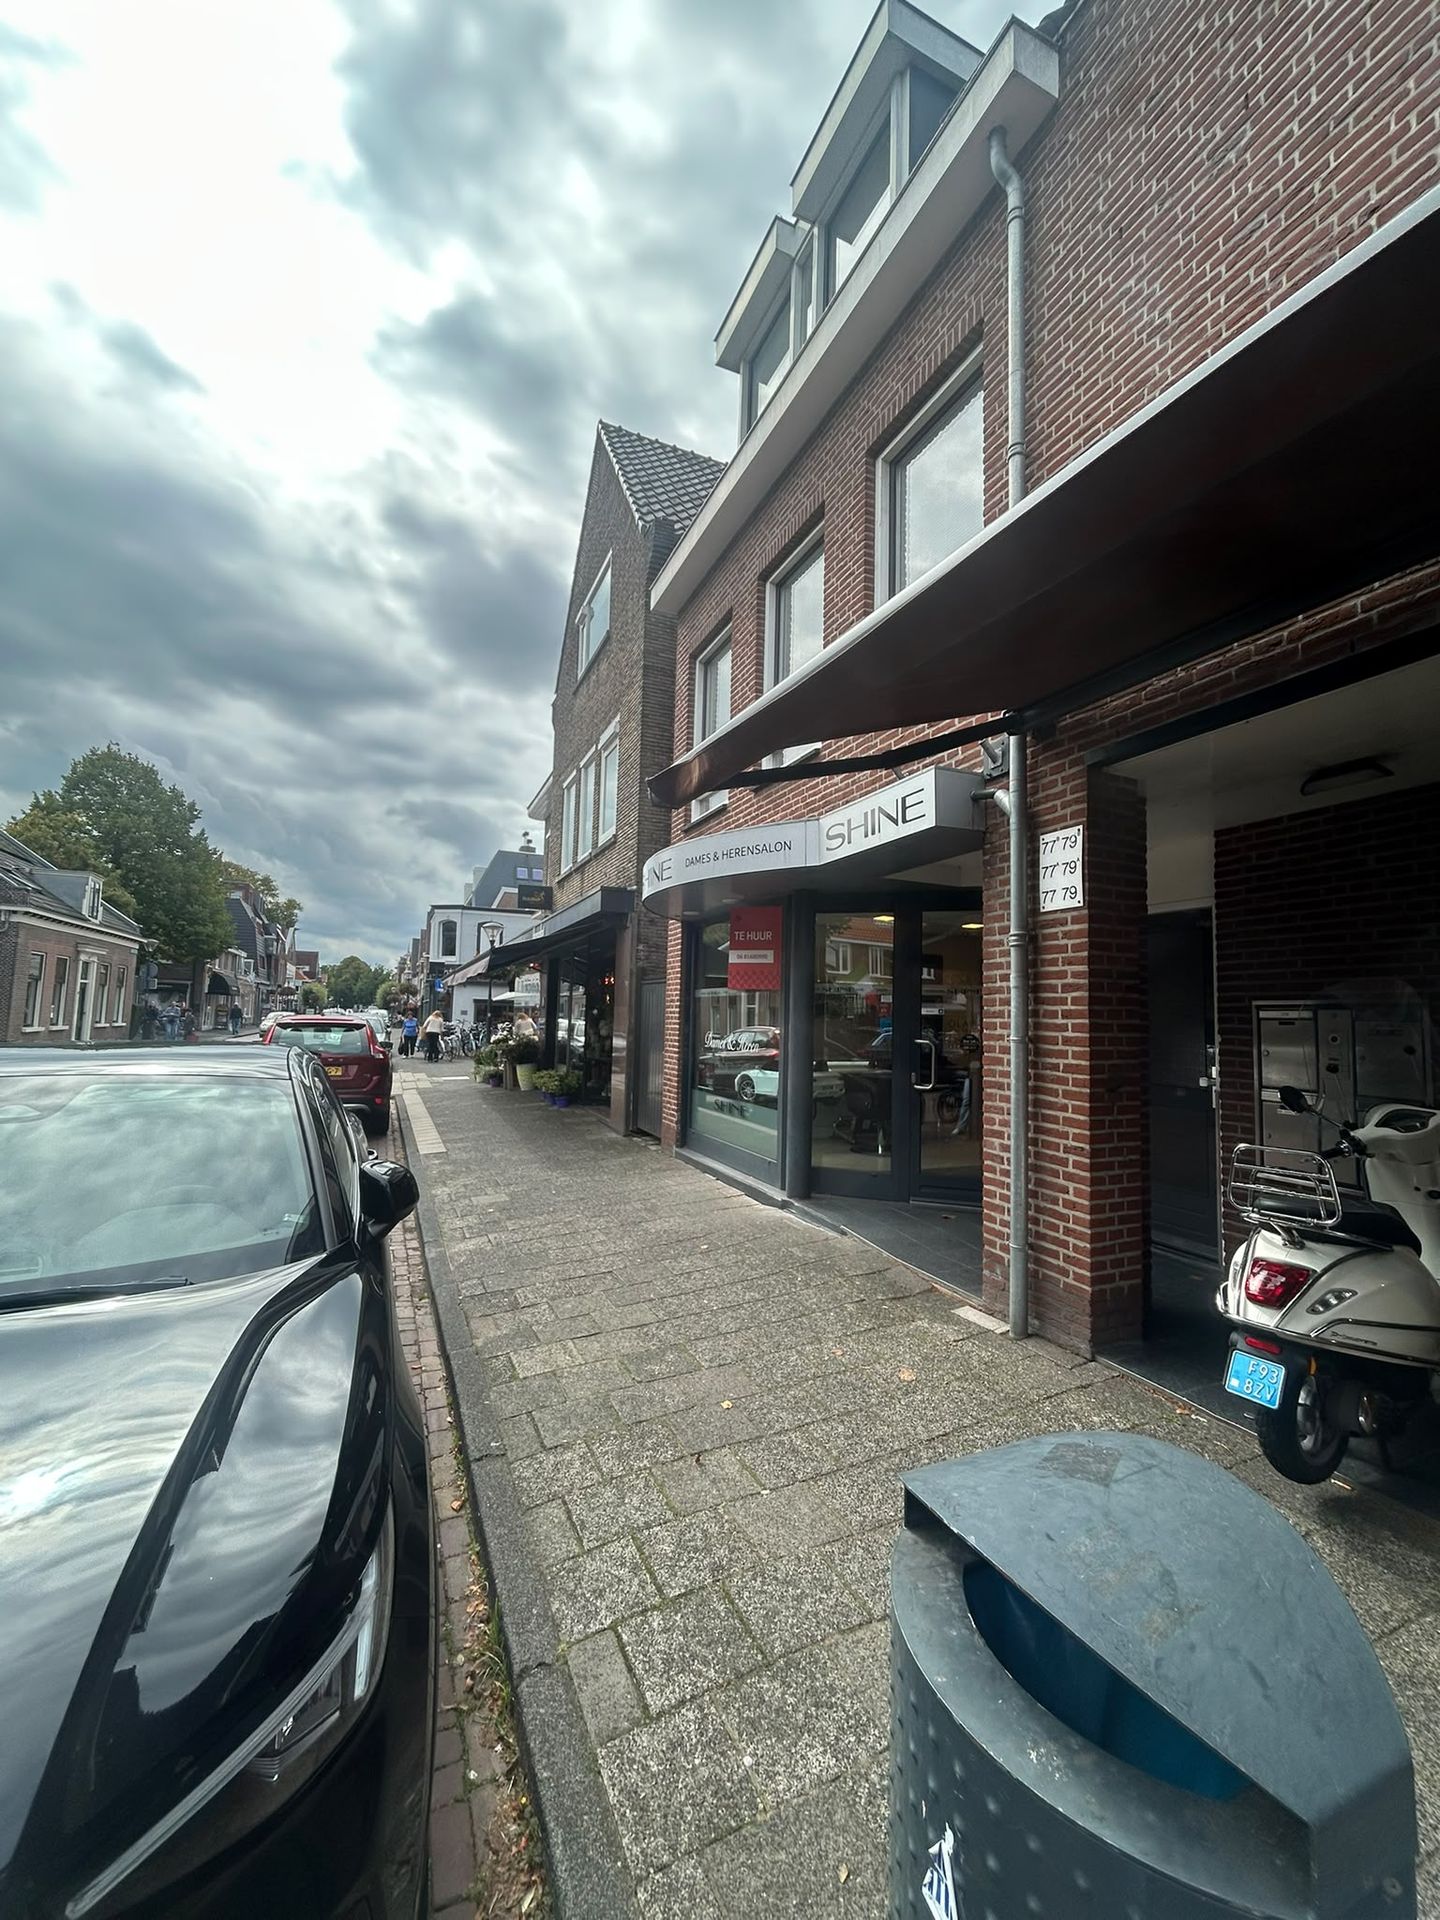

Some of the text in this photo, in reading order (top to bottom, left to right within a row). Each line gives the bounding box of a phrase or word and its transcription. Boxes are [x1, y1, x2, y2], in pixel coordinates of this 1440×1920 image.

[825, 787, 926, 852] SHINE
[684, 840, 792, 868] DAMES & HERENSALON
[1041, 885, 1078, 904] 77 79
[734, 930, 773, 940] TE HUUR
[1248, 1360, 1279, 1384] F93
[1243, 1378, 1276, 1401] 8ZV
